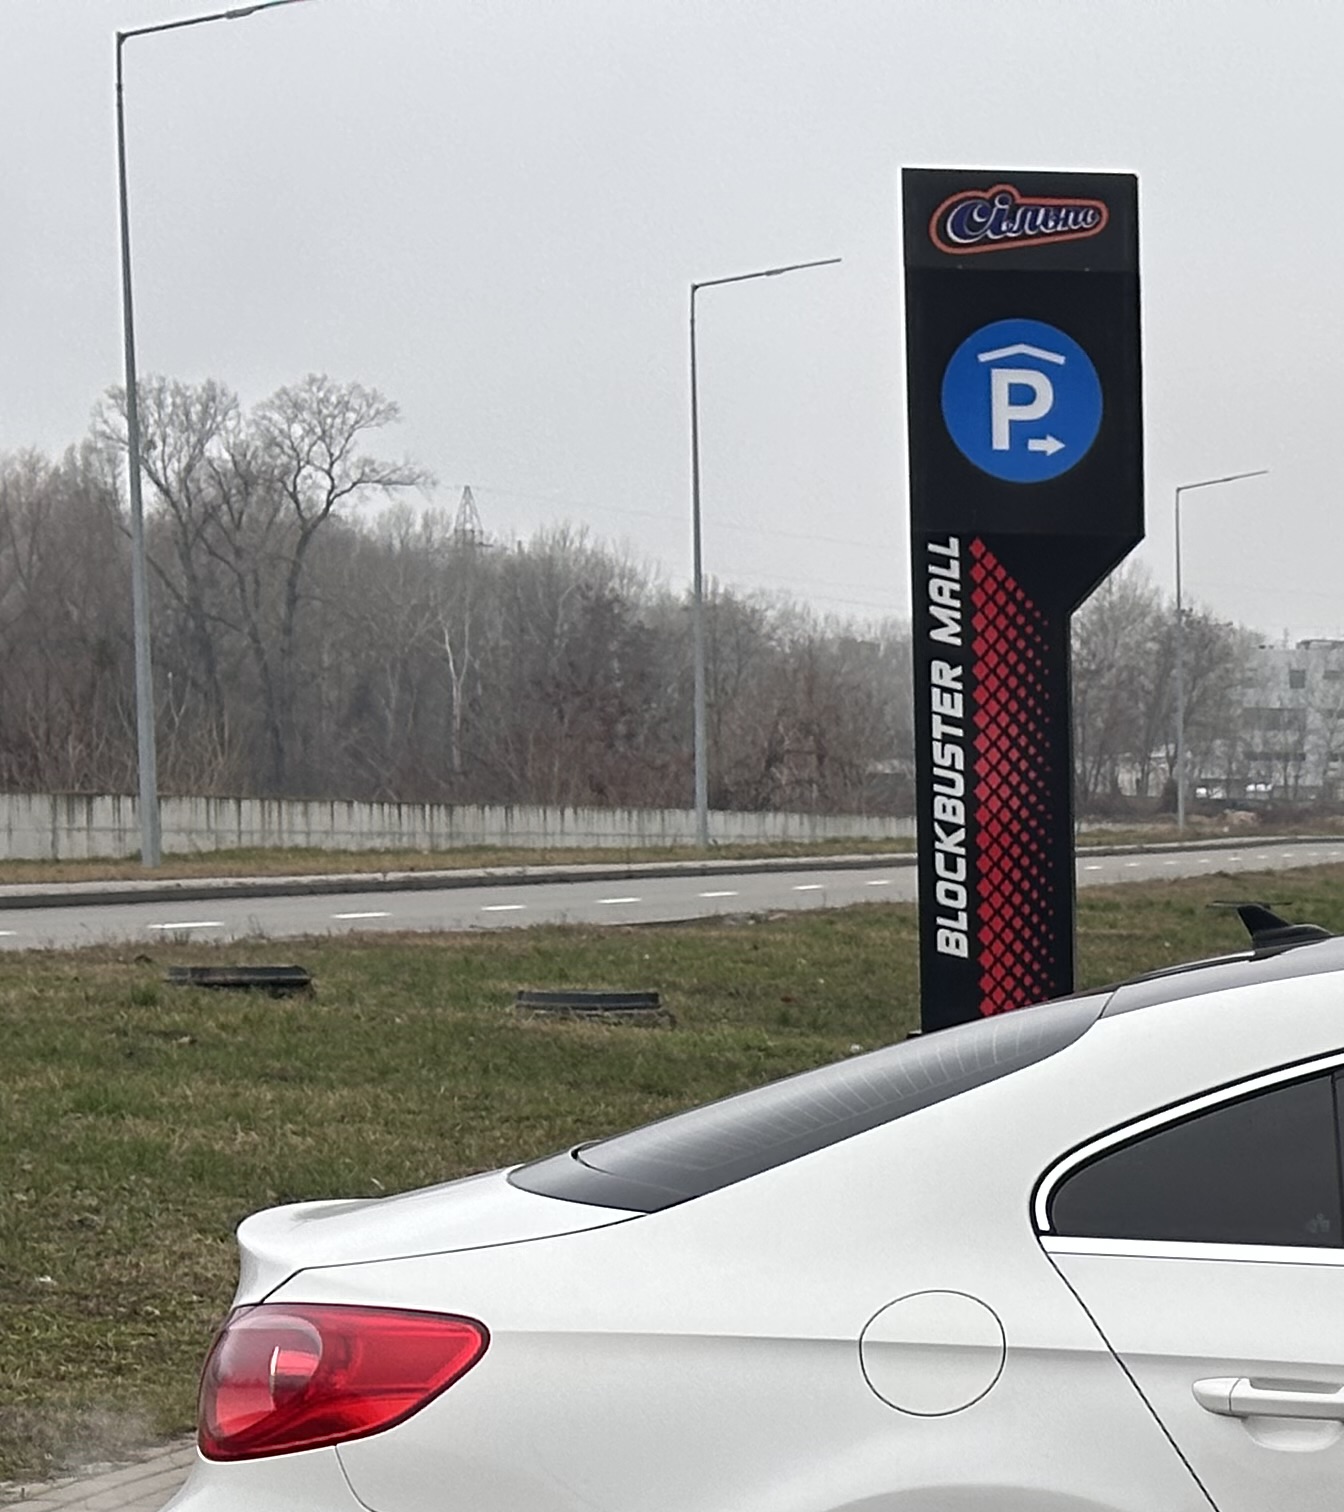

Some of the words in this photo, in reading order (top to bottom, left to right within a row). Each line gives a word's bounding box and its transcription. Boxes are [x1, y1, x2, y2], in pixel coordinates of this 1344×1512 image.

[990, 368, 1055, 451] P
[927, 536, 963, 647] MALL
[929, 659, 969, 959] BLOCKBUSTER
